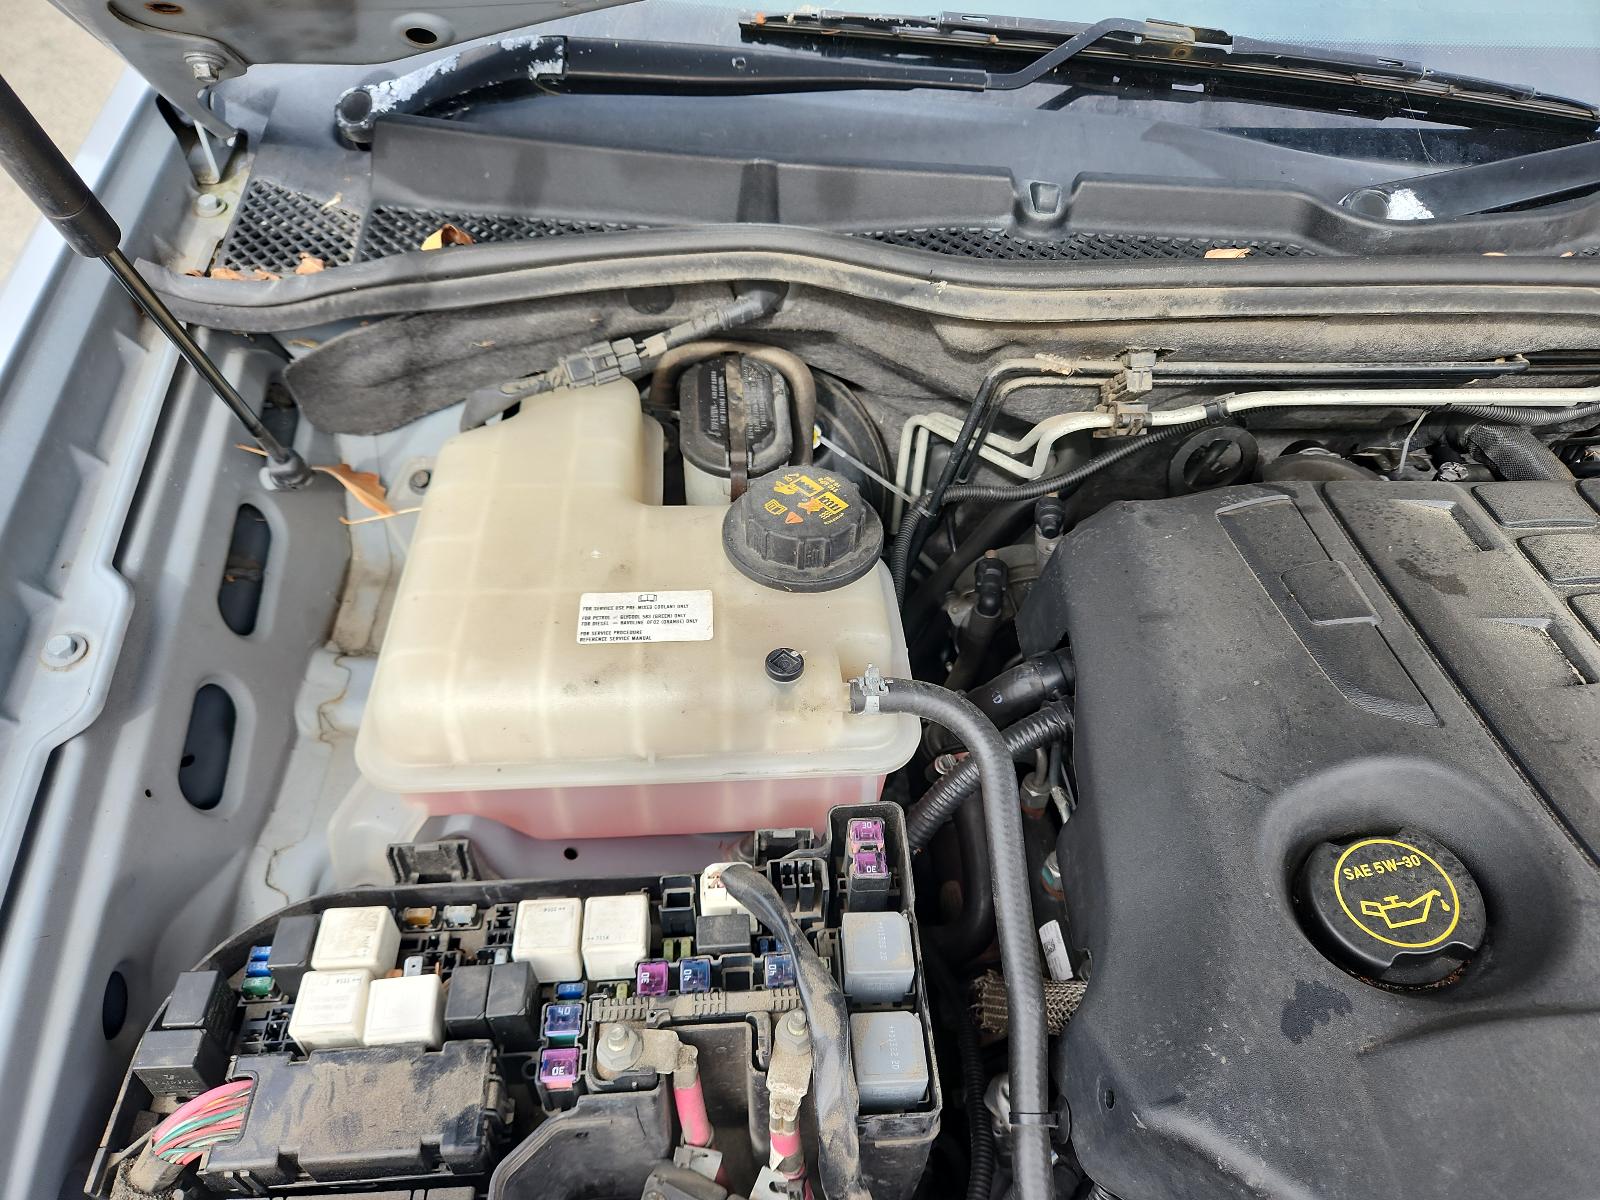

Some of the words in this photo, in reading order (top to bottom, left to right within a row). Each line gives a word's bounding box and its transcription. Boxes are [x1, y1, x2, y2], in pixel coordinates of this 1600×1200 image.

[1343, 864, 1373, 880] SAE
[1373, 854, 1421, 874] 5W-30
[684, 969, 692, 981] 40
[768, 964, 777, 976] 40
[641, 972, 650, 984] 30
[558, 1006, 571, 1015] 40
[551, 1066, 566, 1076] 30
